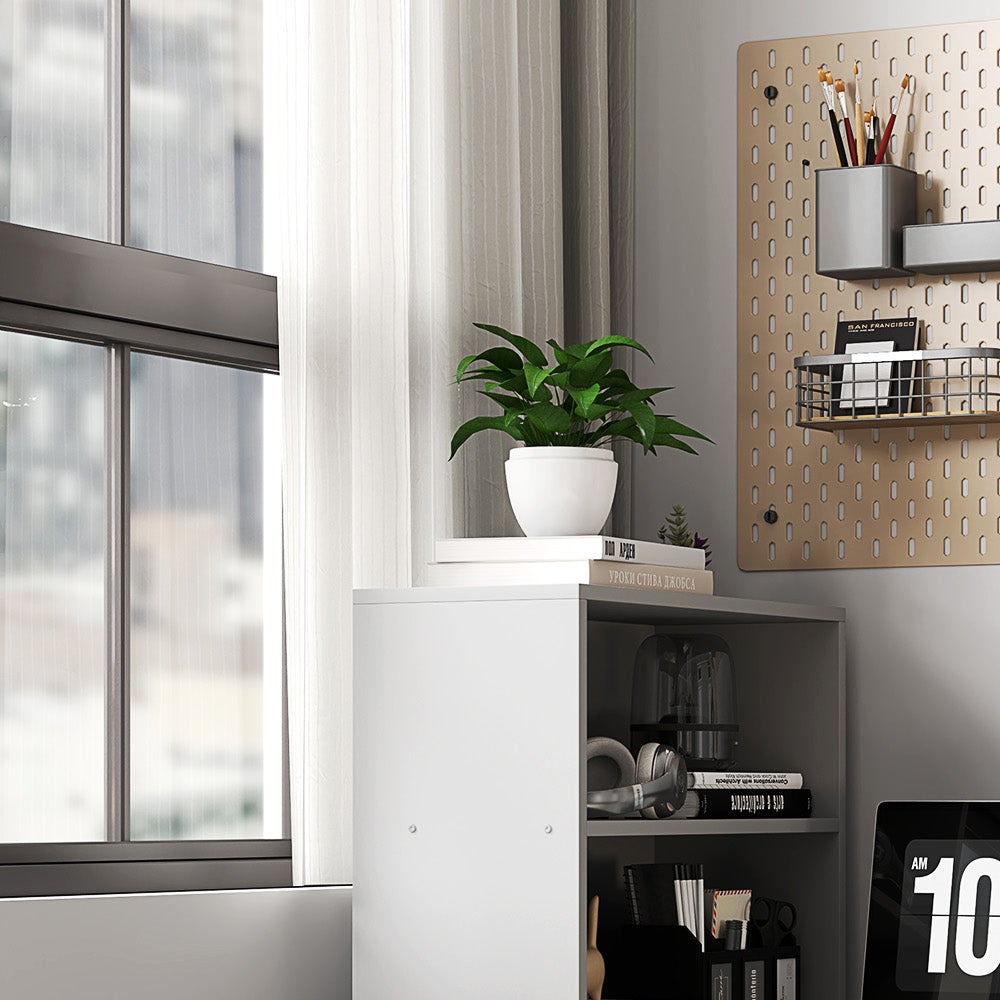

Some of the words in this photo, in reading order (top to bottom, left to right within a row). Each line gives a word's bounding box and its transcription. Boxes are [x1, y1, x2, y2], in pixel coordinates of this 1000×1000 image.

[619, 542, 636, 560] АРДЕН
[609, 570, 635, 585] УРОКИ
[637, 573, 662, 588] СТИВА
[663, 575, 696, 590] ДЖОБСА
[731, 795, 764, 814] architecture
[773, 795, 784, 812] arts
[911, 857, 928, 870] AM
